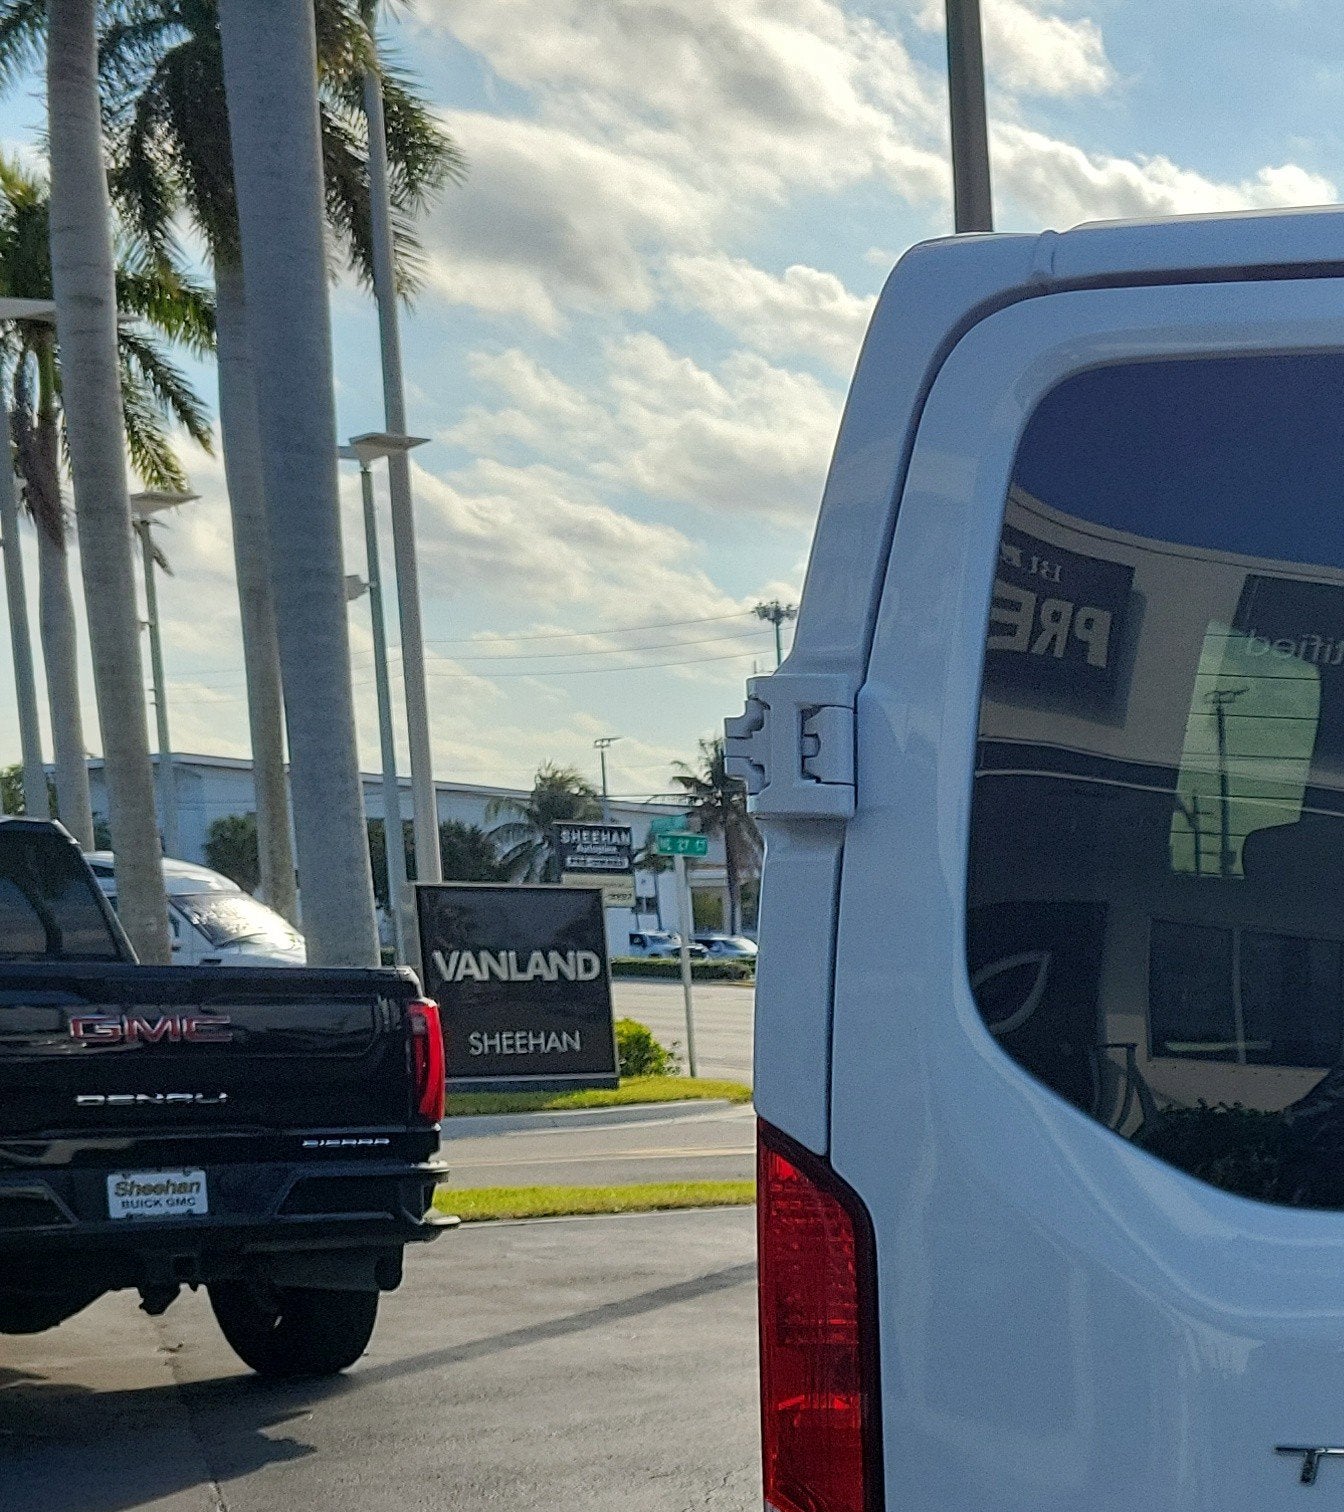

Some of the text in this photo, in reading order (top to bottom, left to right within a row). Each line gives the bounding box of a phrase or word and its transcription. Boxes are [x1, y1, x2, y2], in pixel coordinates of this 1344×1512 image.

[561, 827, 631, 845] SHEEHAN
[432, 949, 601, 982] VANLAND
[69, 1014, 233, 1043] GMC
[467, 1029, 581, 1056] SHEEHAN
[114, 1178, 202, 1197] Sheehan
[121, 1196, 196, 1209] BUICK GMC
